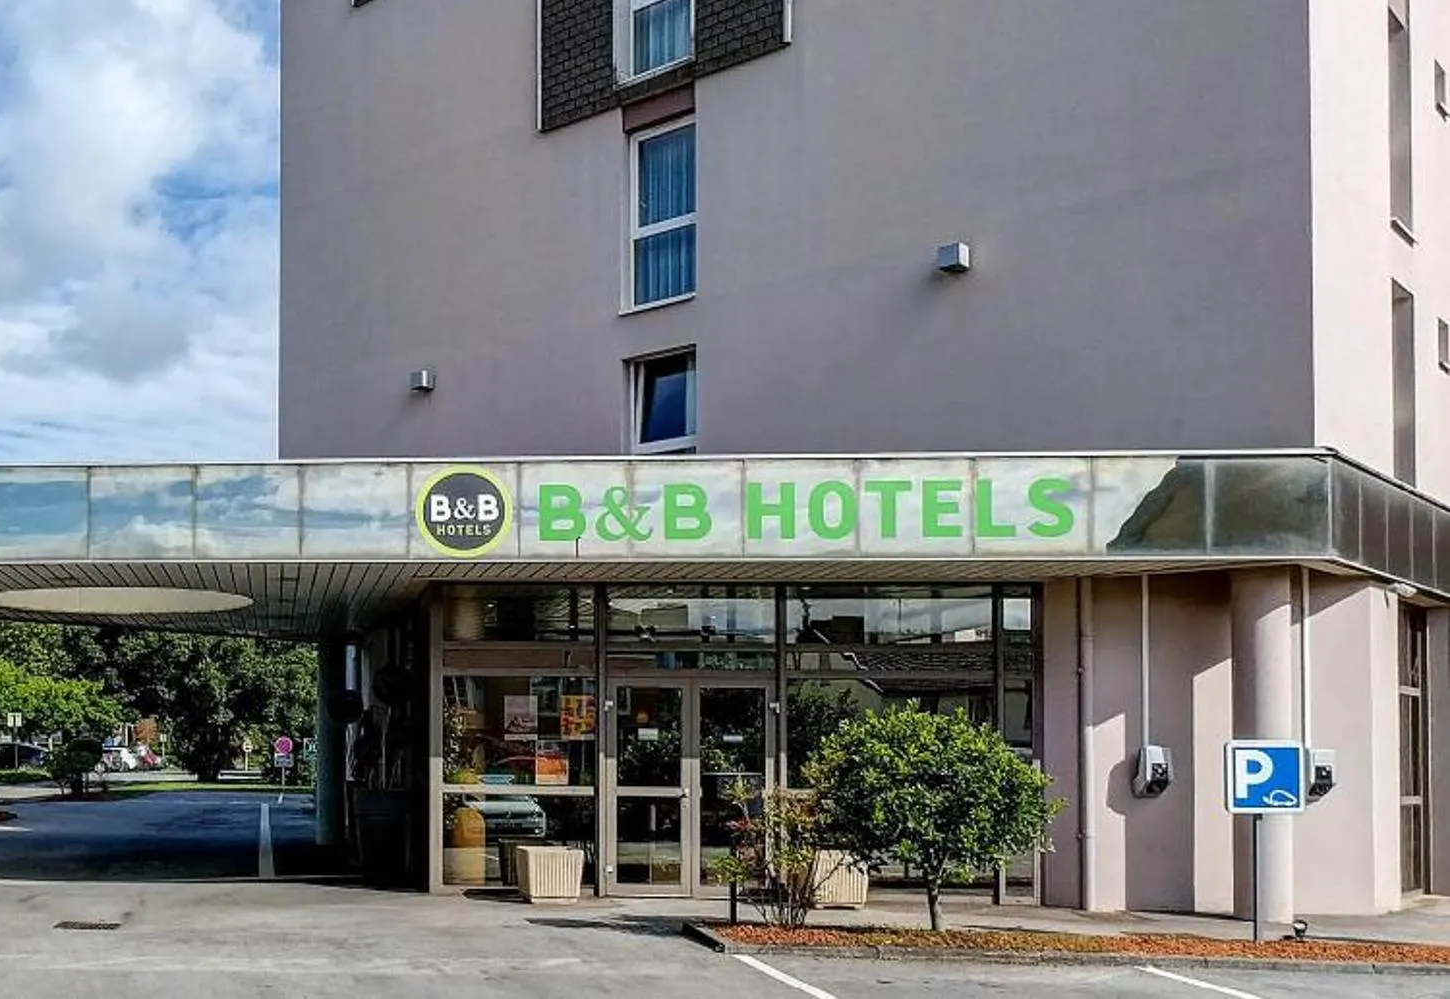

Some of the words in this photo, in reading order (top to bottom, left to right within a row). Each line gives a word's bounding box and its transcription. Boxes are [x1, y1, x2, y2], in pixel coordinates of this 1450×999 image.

[430, 494, 499, 522] B&B
[538, 483, 713, 542] B&B
[749, 478, 1075, 539] HOTELS
[436, 524, 492, 536] HOTELS
[1235, 749, 1273, 798] P
